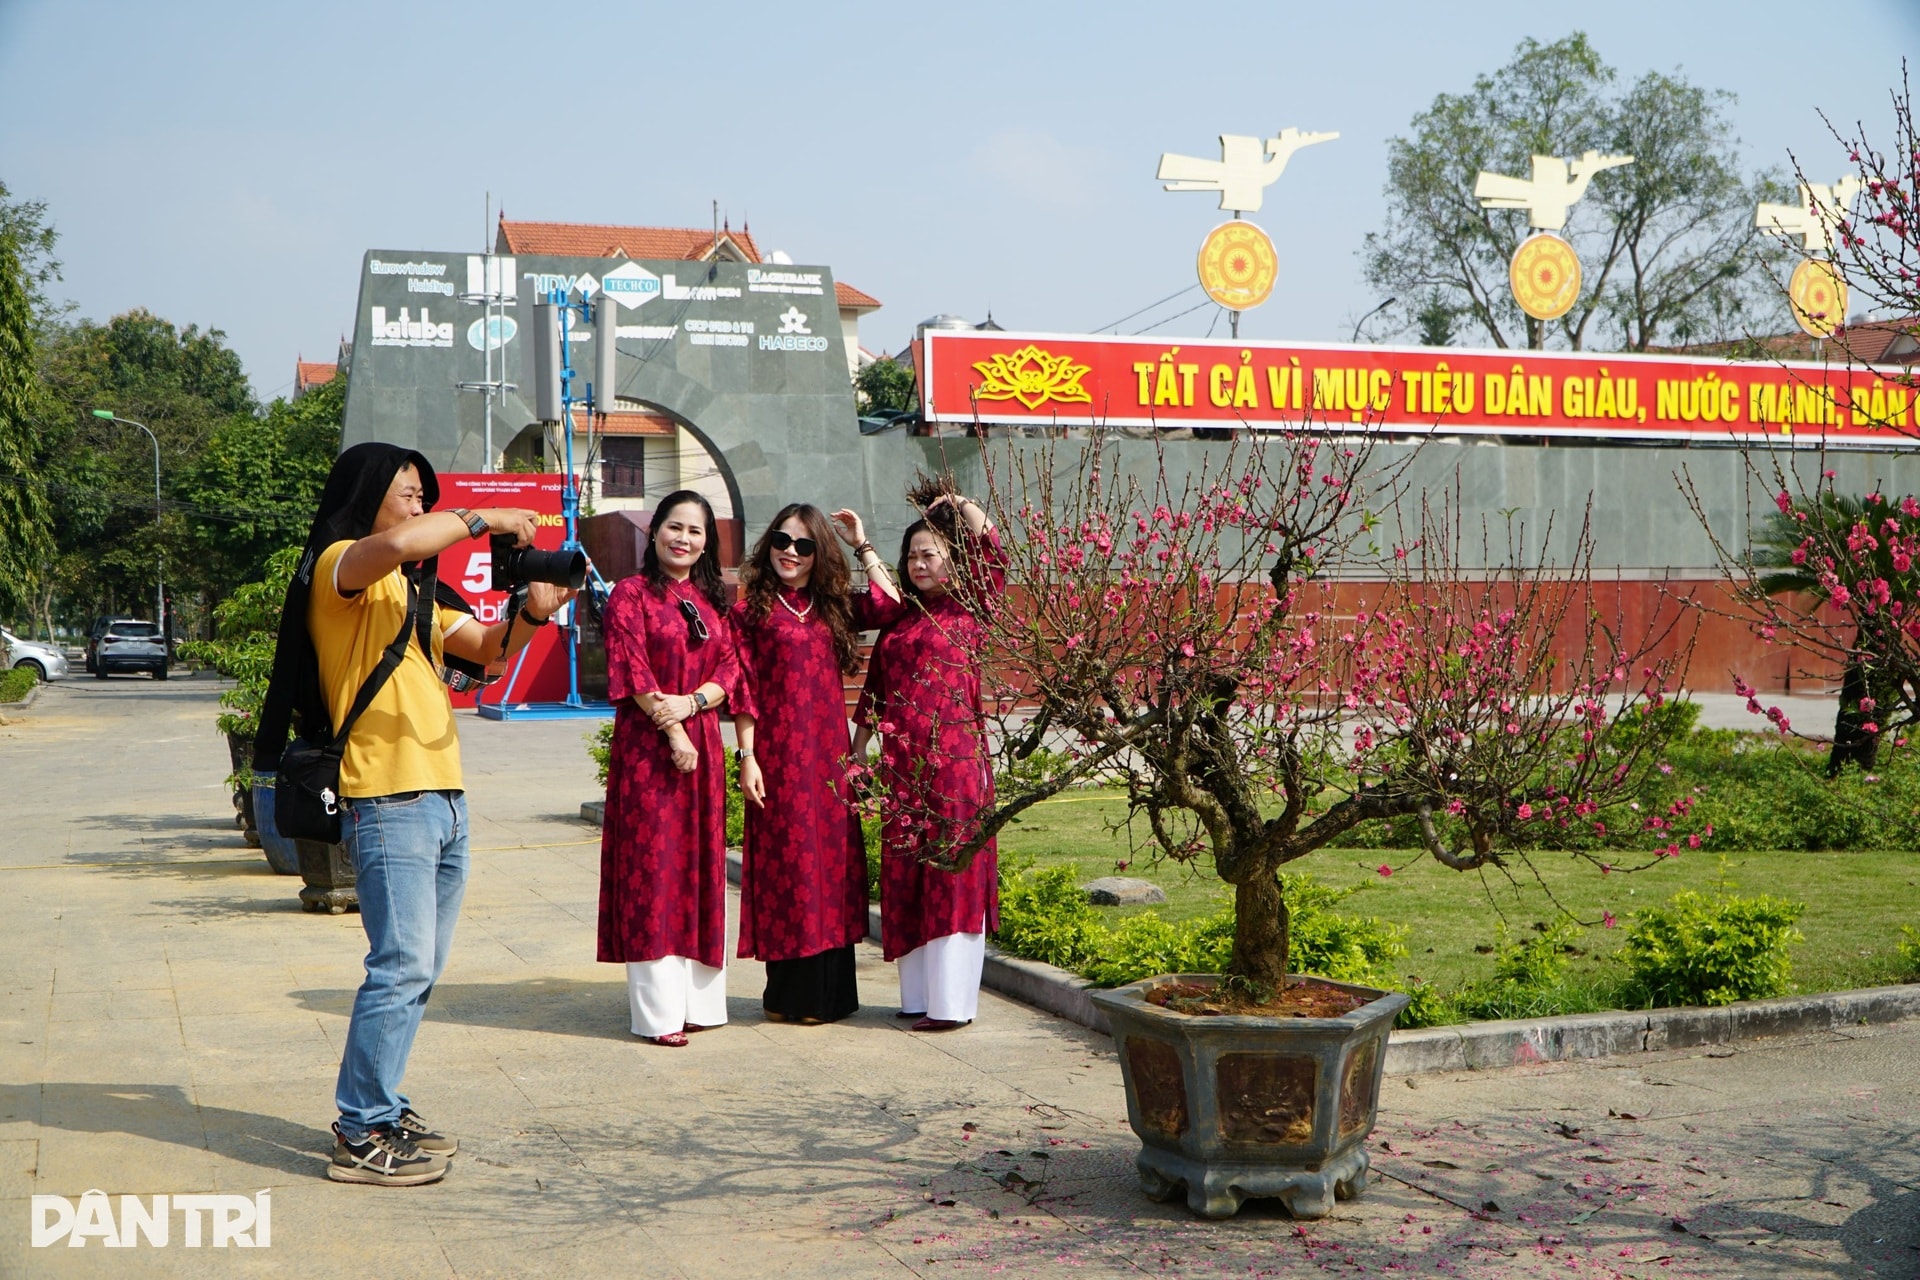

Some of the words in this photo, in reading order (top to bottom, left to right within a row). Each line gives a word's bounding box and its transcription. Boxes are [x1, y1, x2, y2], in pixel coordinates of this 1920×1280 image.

[371, 260, 446, 276] Eurowindow
[408, 278, 454, 296] Holding
[609, 279, 653, 292] TECHCO
[759, 335, 828, 352] HABECO
[1133, 347, 1199, 406] TẤT
[1210, 349, 1258, 408] CẢ
[1267, 356, 1302, 410] VÌ
[1313, 367, 1392, 422] MỤC
[1402, 362, 1475, 414] TIÊU
[1485, 364, 1552, 416] DÂN
[1563, 367, 1647, 424] GIÀU,
[1657, 372, 1740, 422] NƯỚC
[1750, 383, 1844, 435] MẠNH,
[1852, 378, 1907, 427] DÂN
